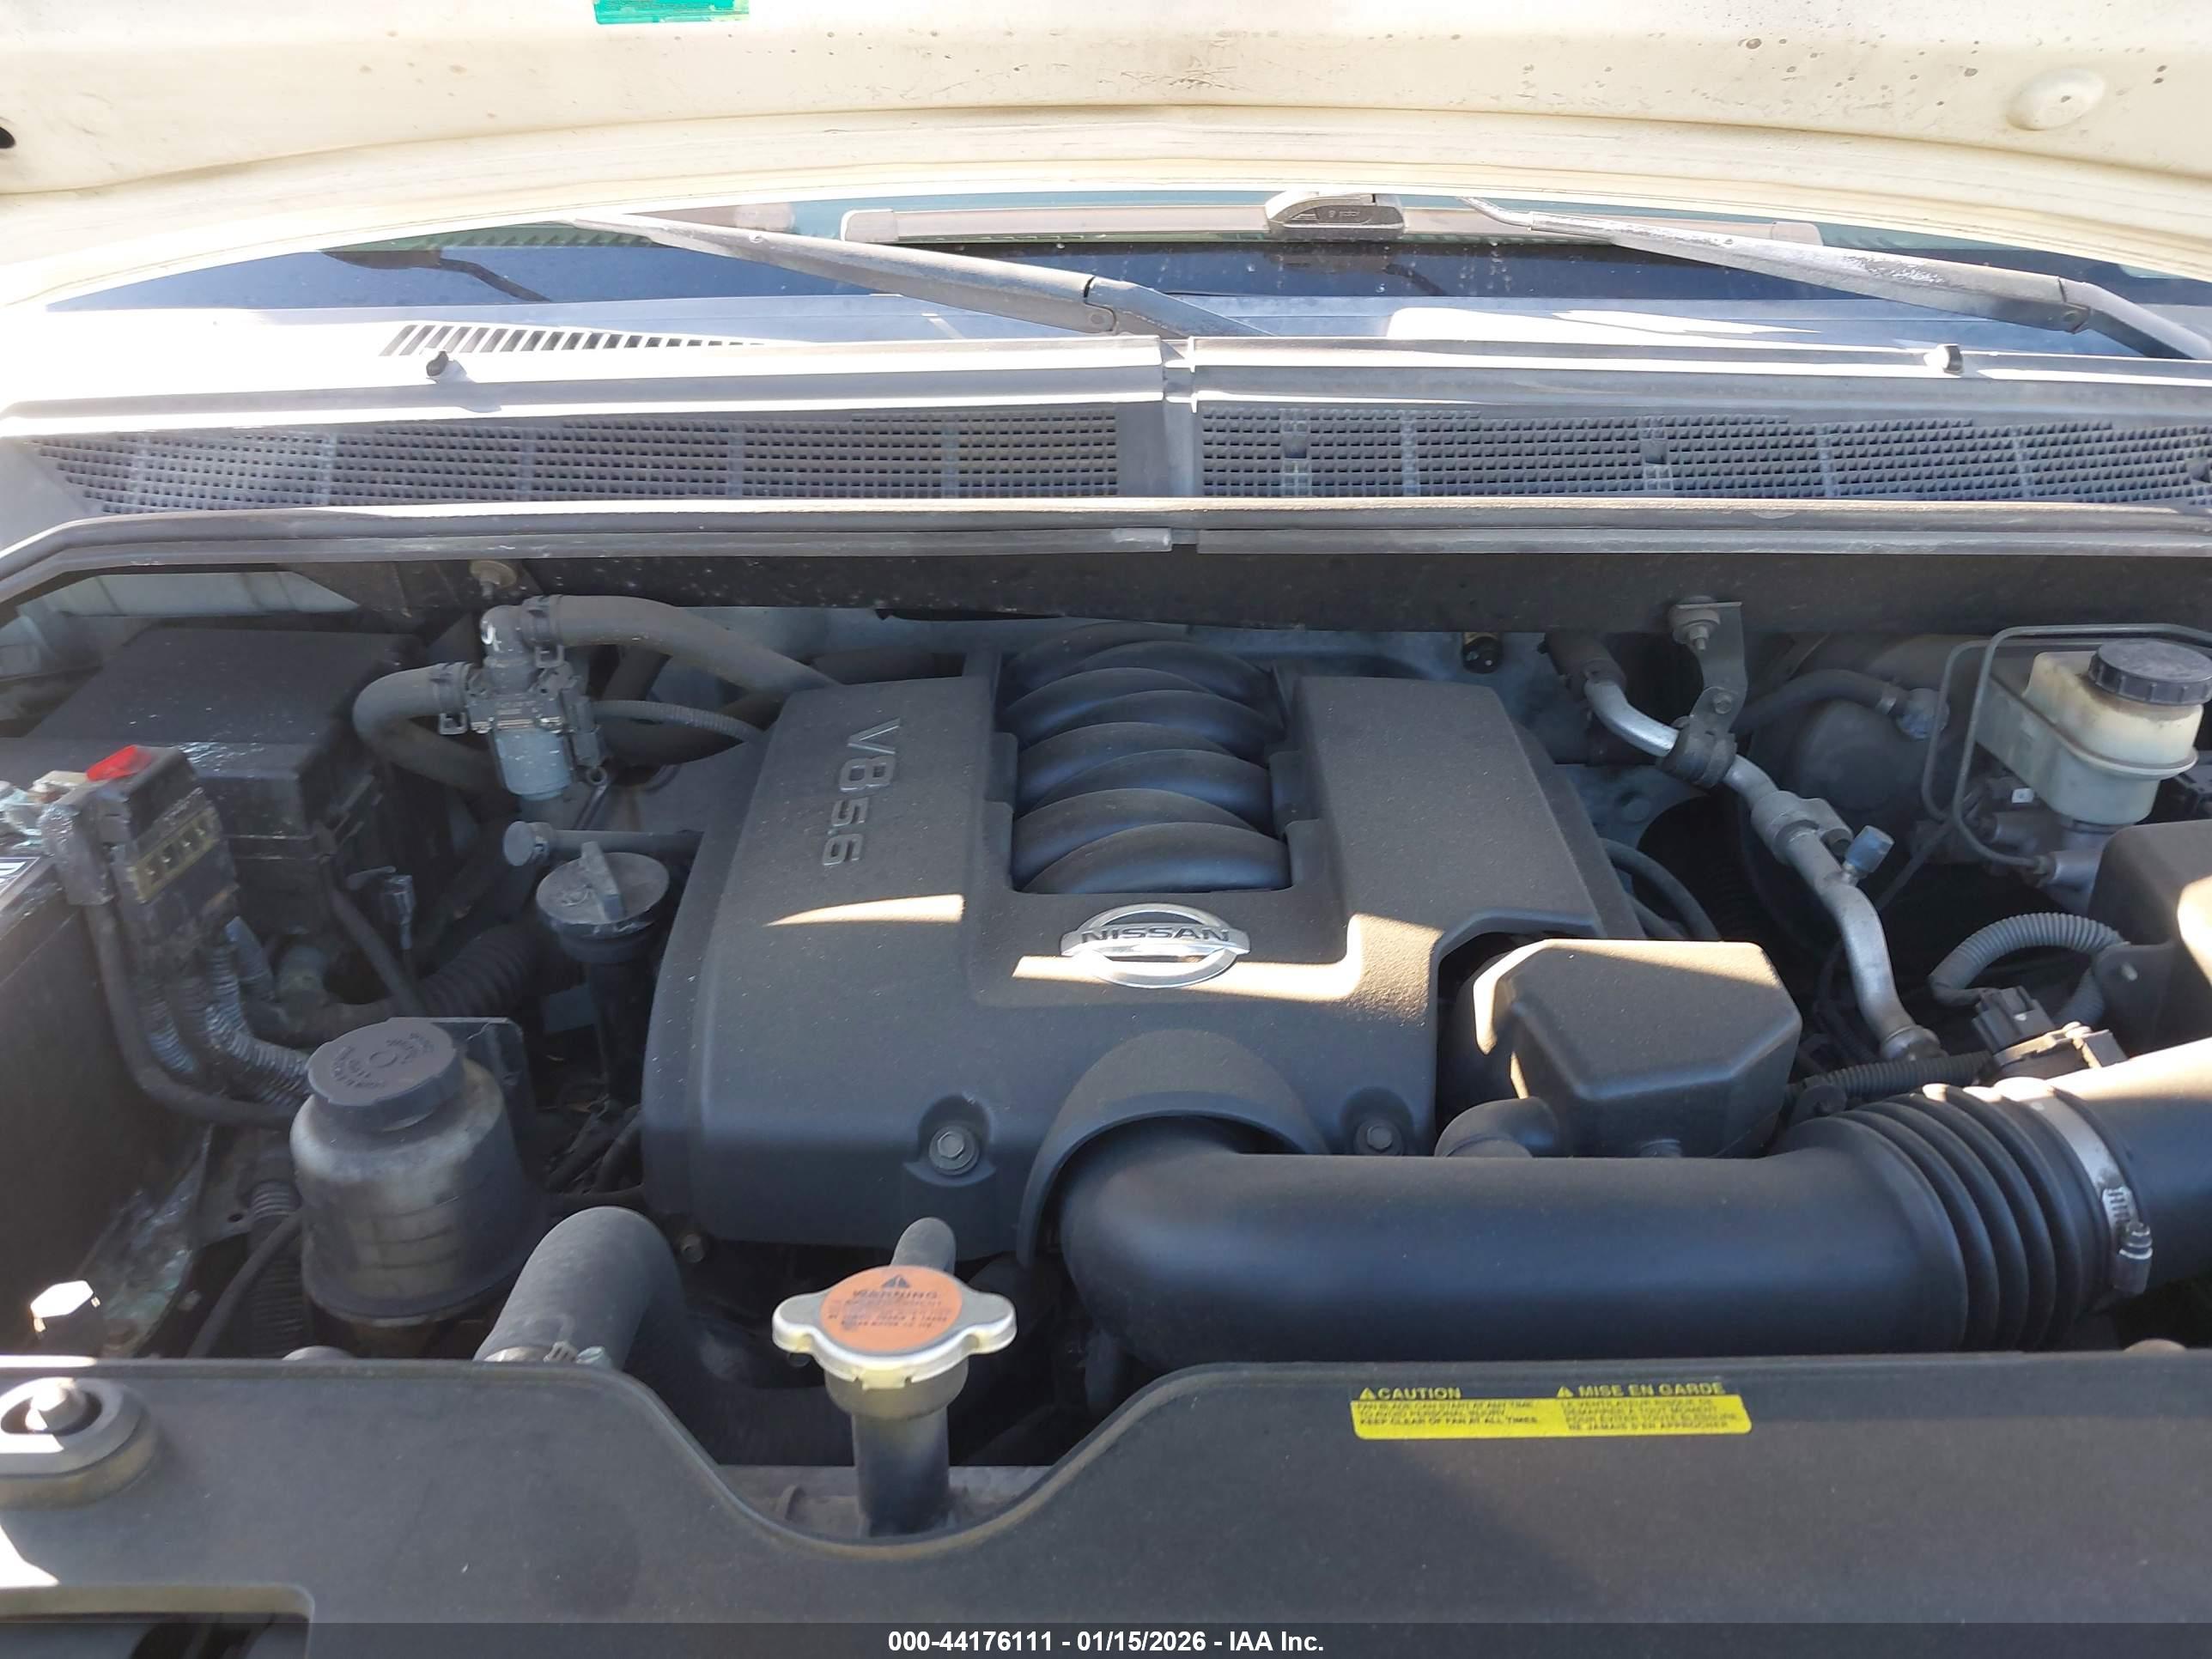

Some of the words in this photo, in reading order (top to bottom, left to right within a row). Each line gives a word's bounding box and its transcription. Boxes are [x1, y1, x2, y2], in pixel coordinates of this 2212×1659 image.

[839, 716, 901, 792] V8
[1081, 927, 1231, 944] NISSAN
[1377, 1387, 1462, 1400] CAUTION
[1578, 1383, 1624, 1397] MISE
[1628, 1383, 1654, 1397] EN
[1659, 1382, 1725, 1396] GARDE
